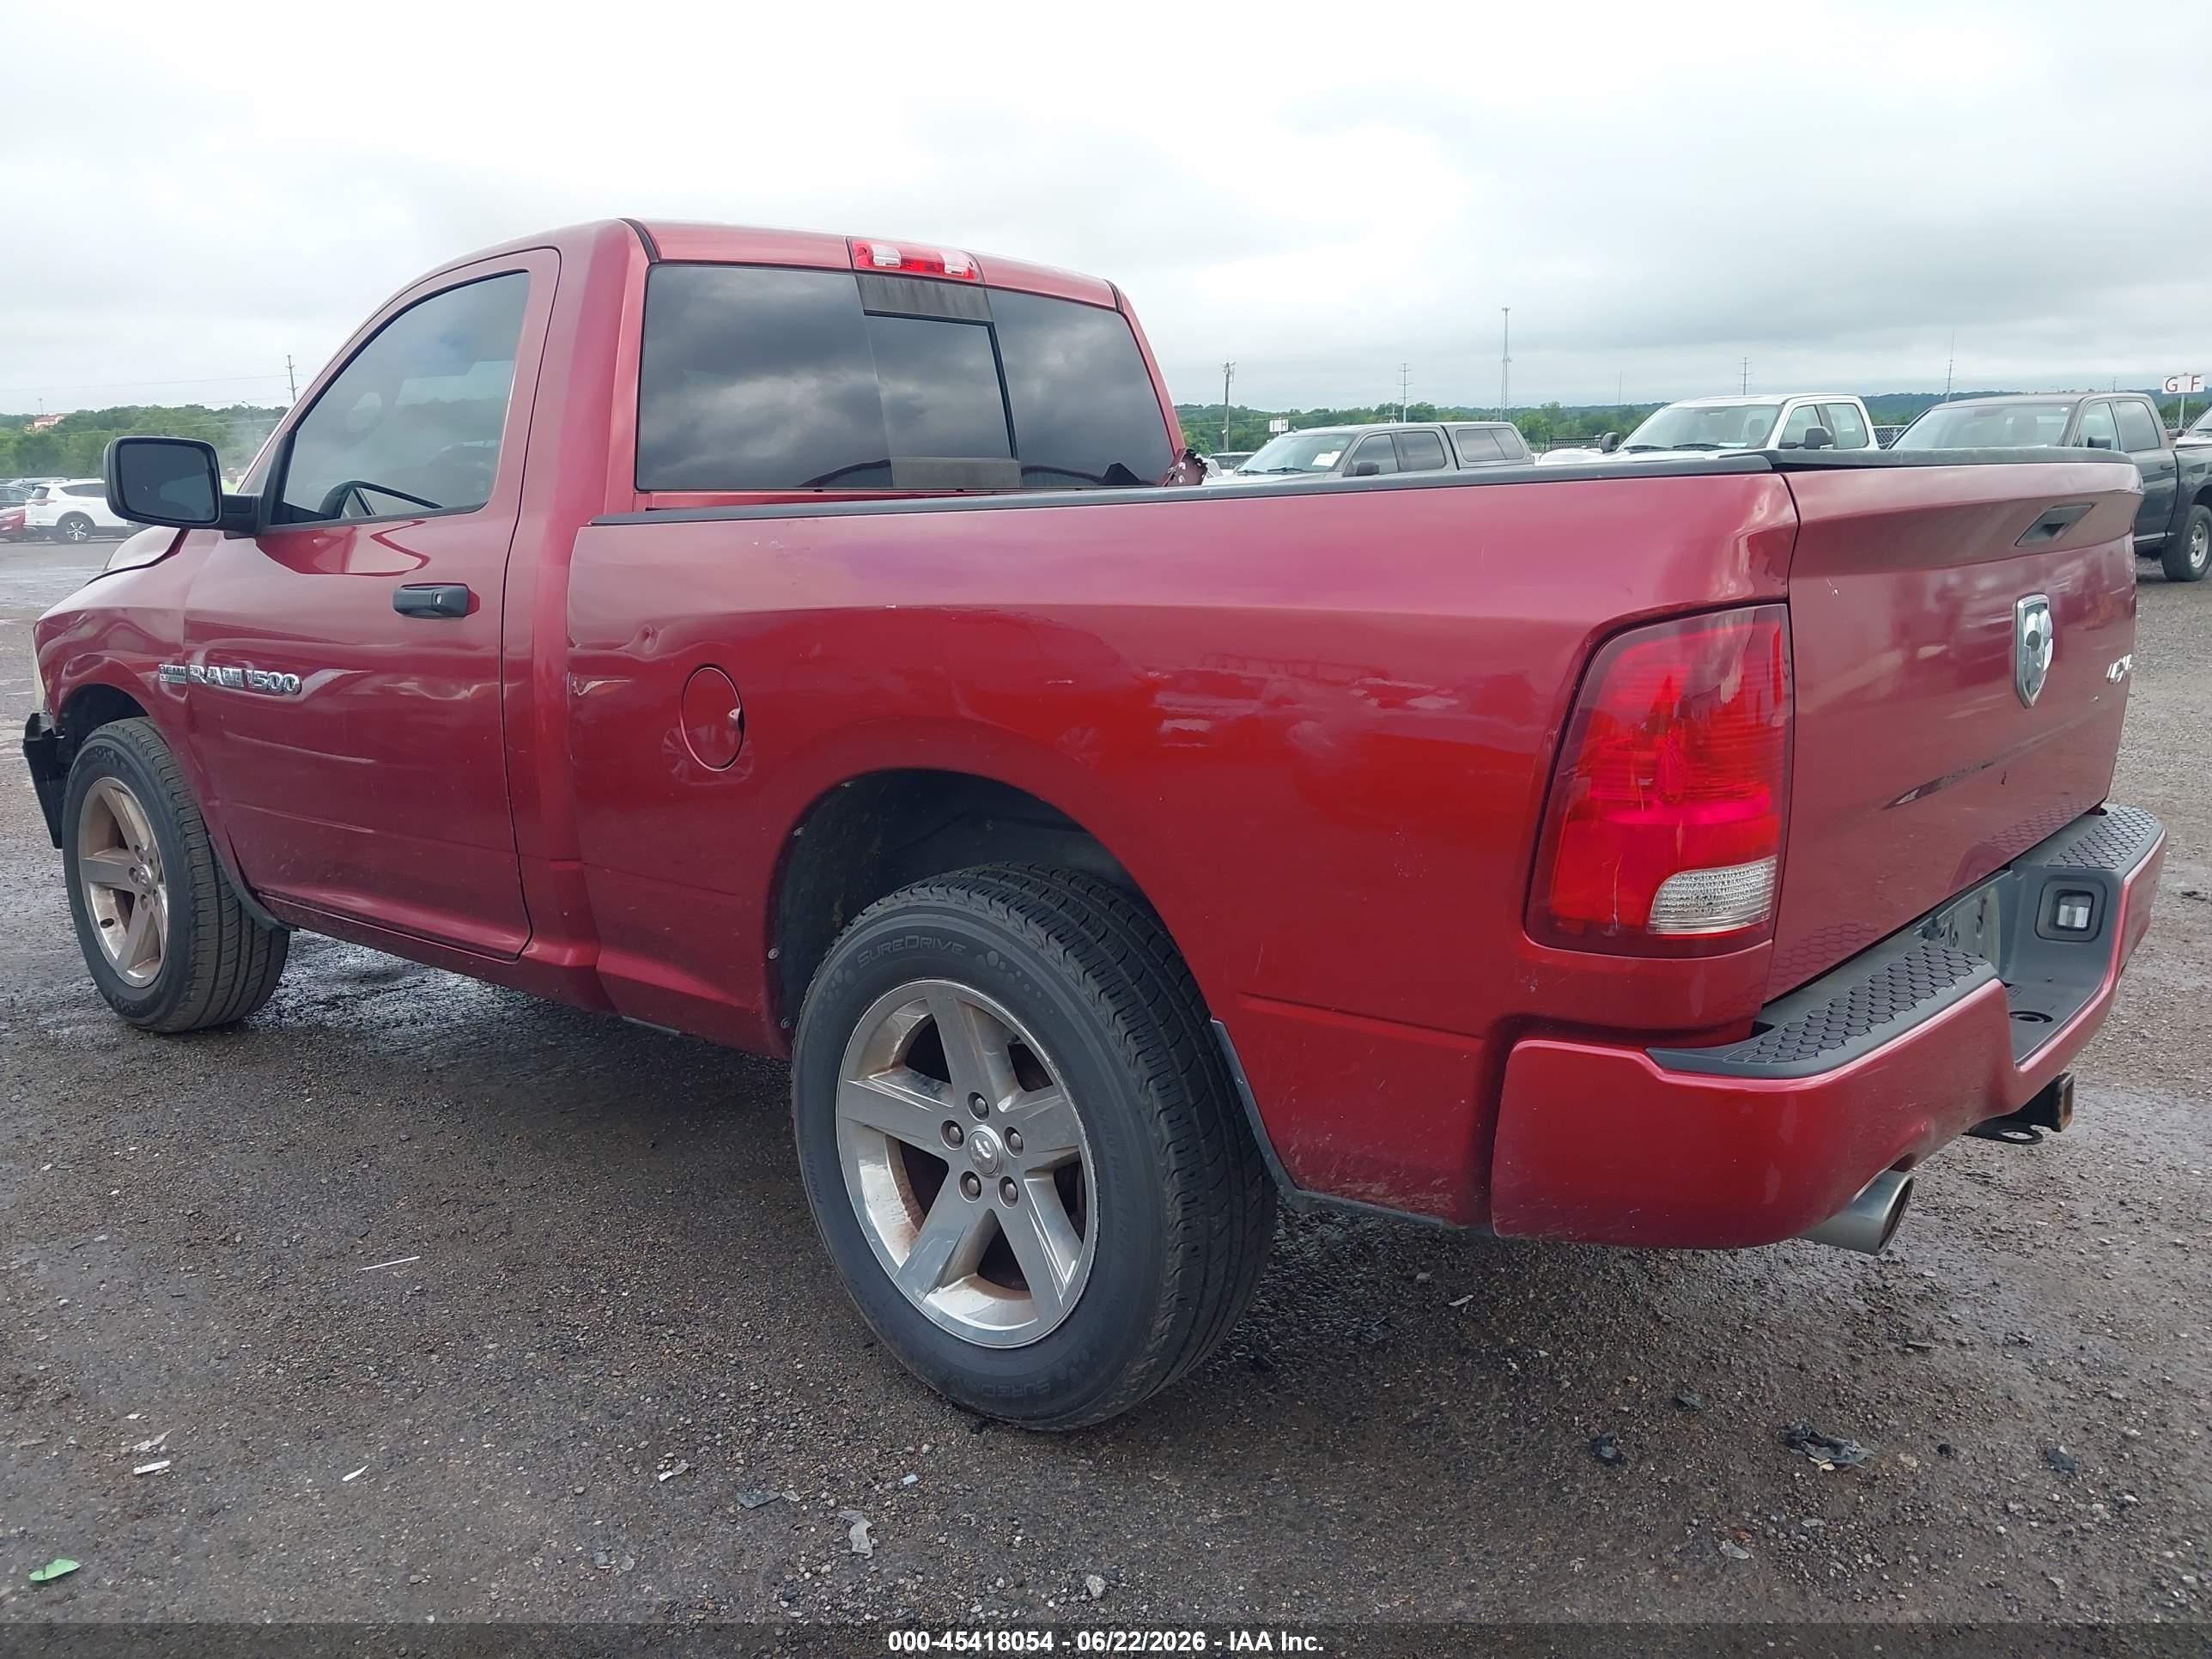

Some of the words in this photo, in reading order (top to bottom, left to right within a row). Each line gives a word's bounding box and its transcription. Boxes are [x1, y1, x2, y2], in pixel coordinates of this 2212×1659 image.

[2165, 376, 2179, 392] G
[2191, 375, 2201, 392] F
[189, 664, 244, 688] RAM
[246, 670, 302, 695] 1500
